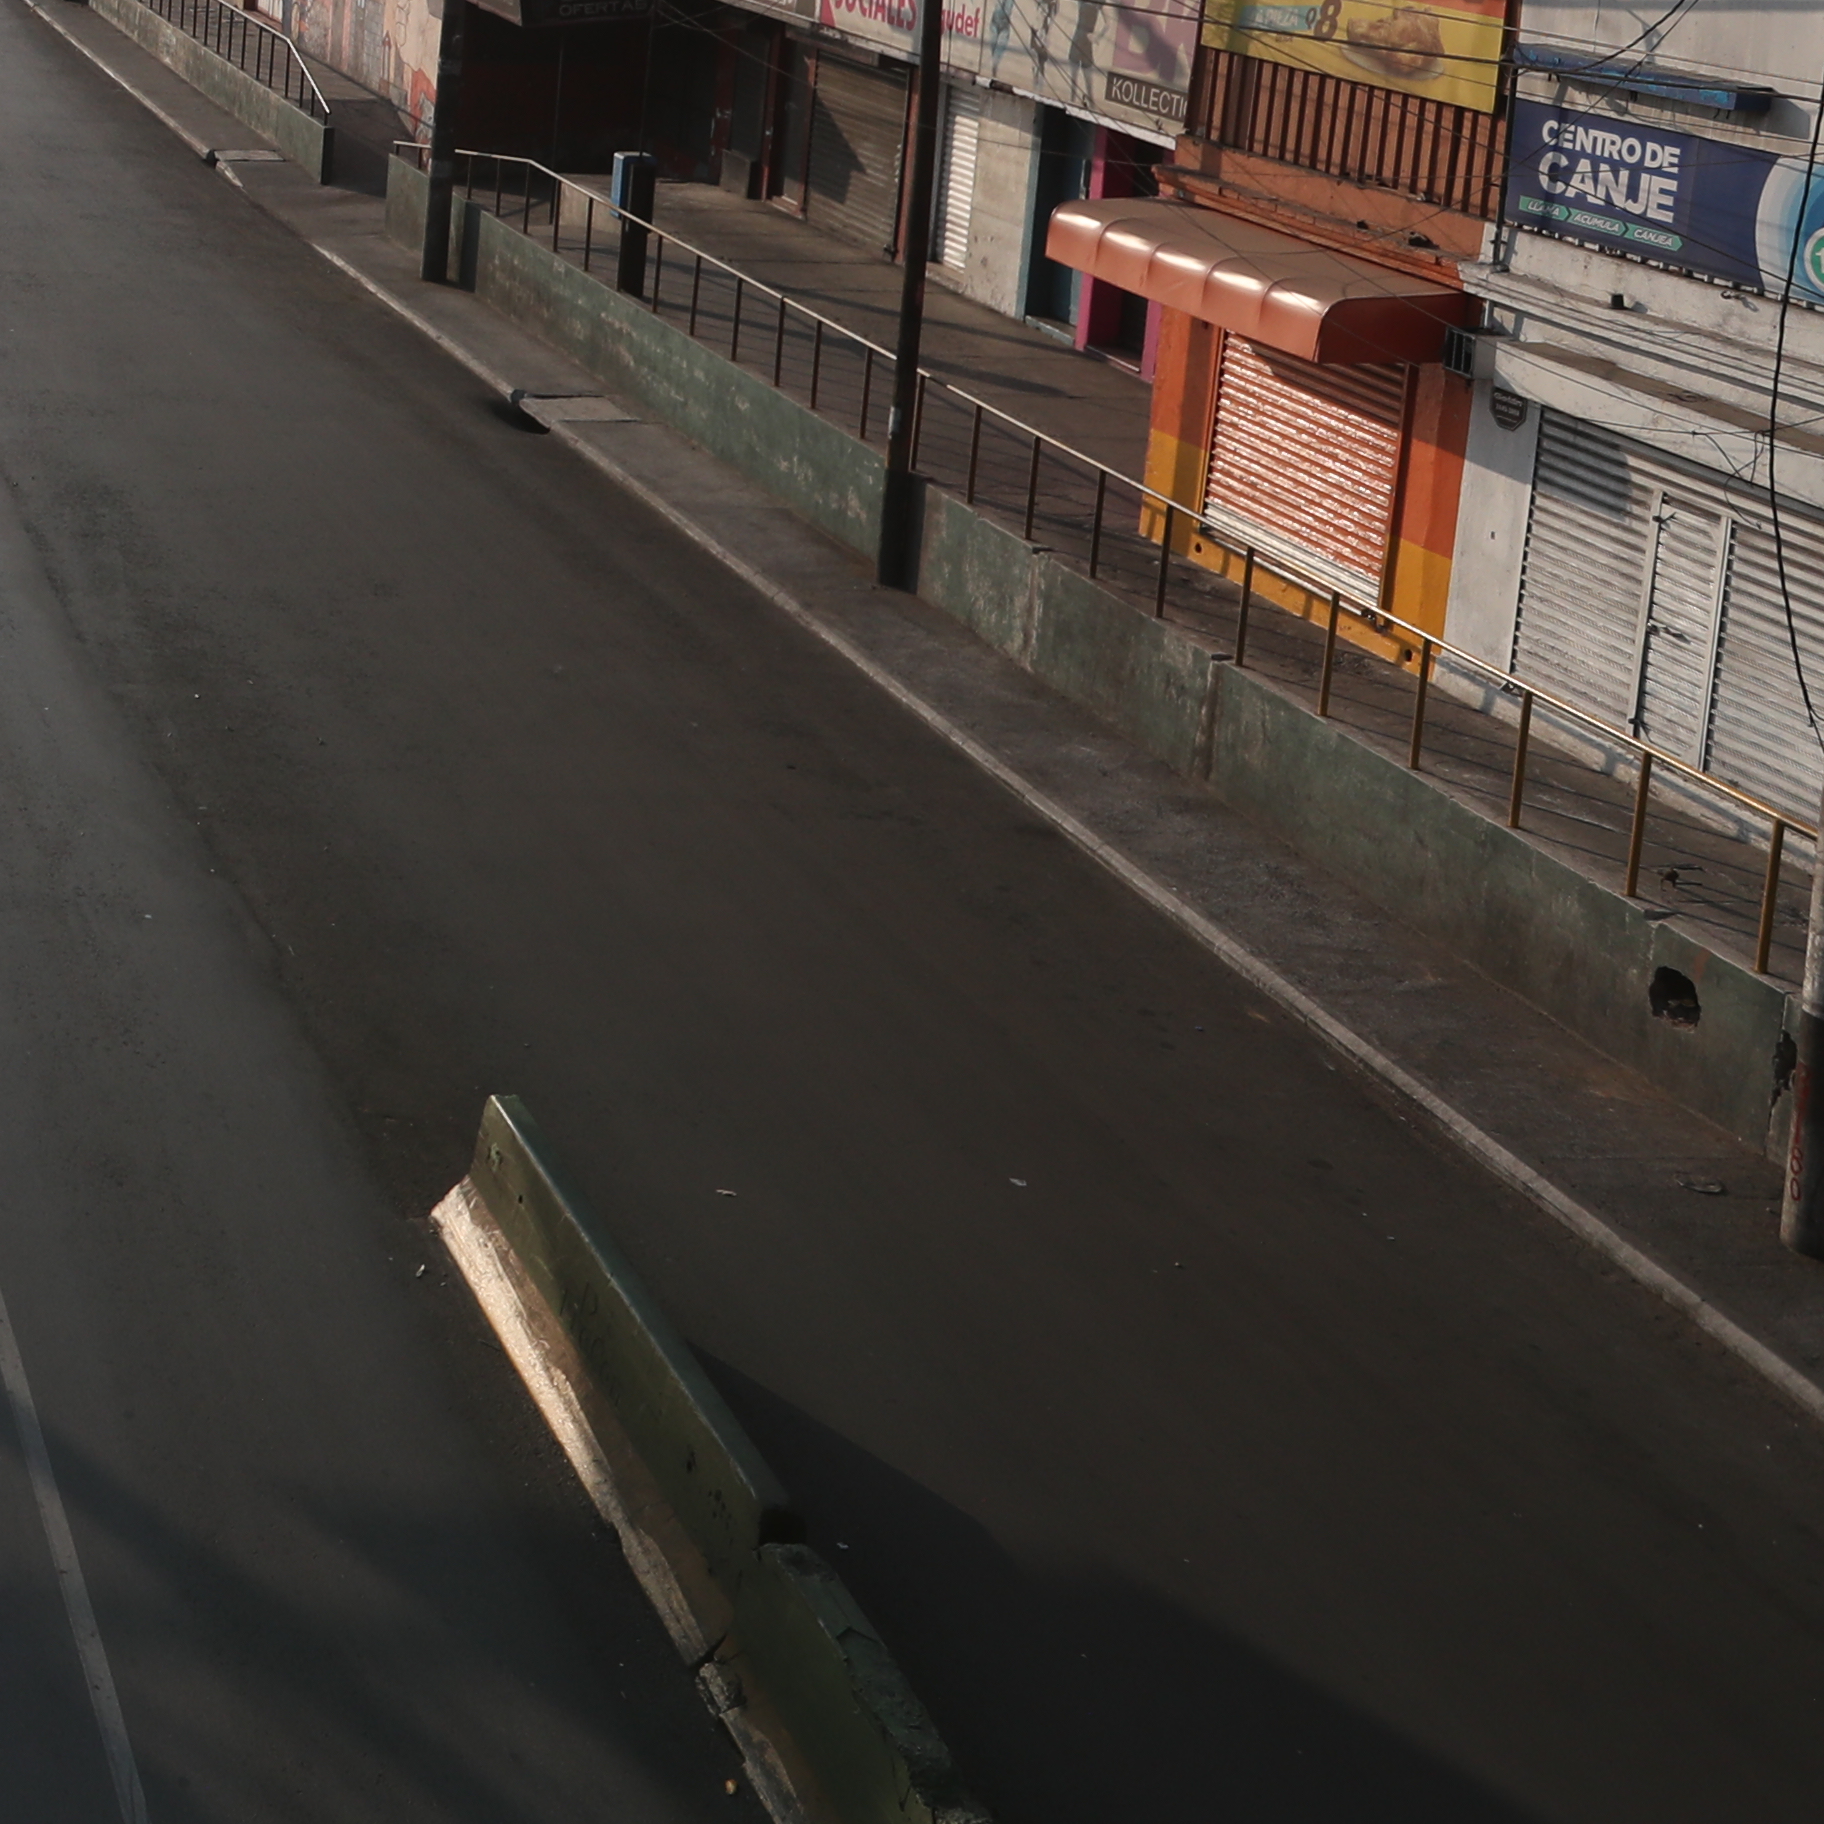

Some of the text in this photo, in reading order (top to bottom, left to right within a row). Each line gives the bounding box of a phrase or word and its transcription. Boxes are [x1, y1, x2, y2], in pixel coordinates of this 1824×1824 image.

[1112, 77, 1188, 119] KOLLECTI
[1542, 120, 1681, 173] CENTRO DE
[1539, 152, 1678, 223] CANJE
[1528, 200, 1673, 246] LLAMA ACUMULA CANJEA
